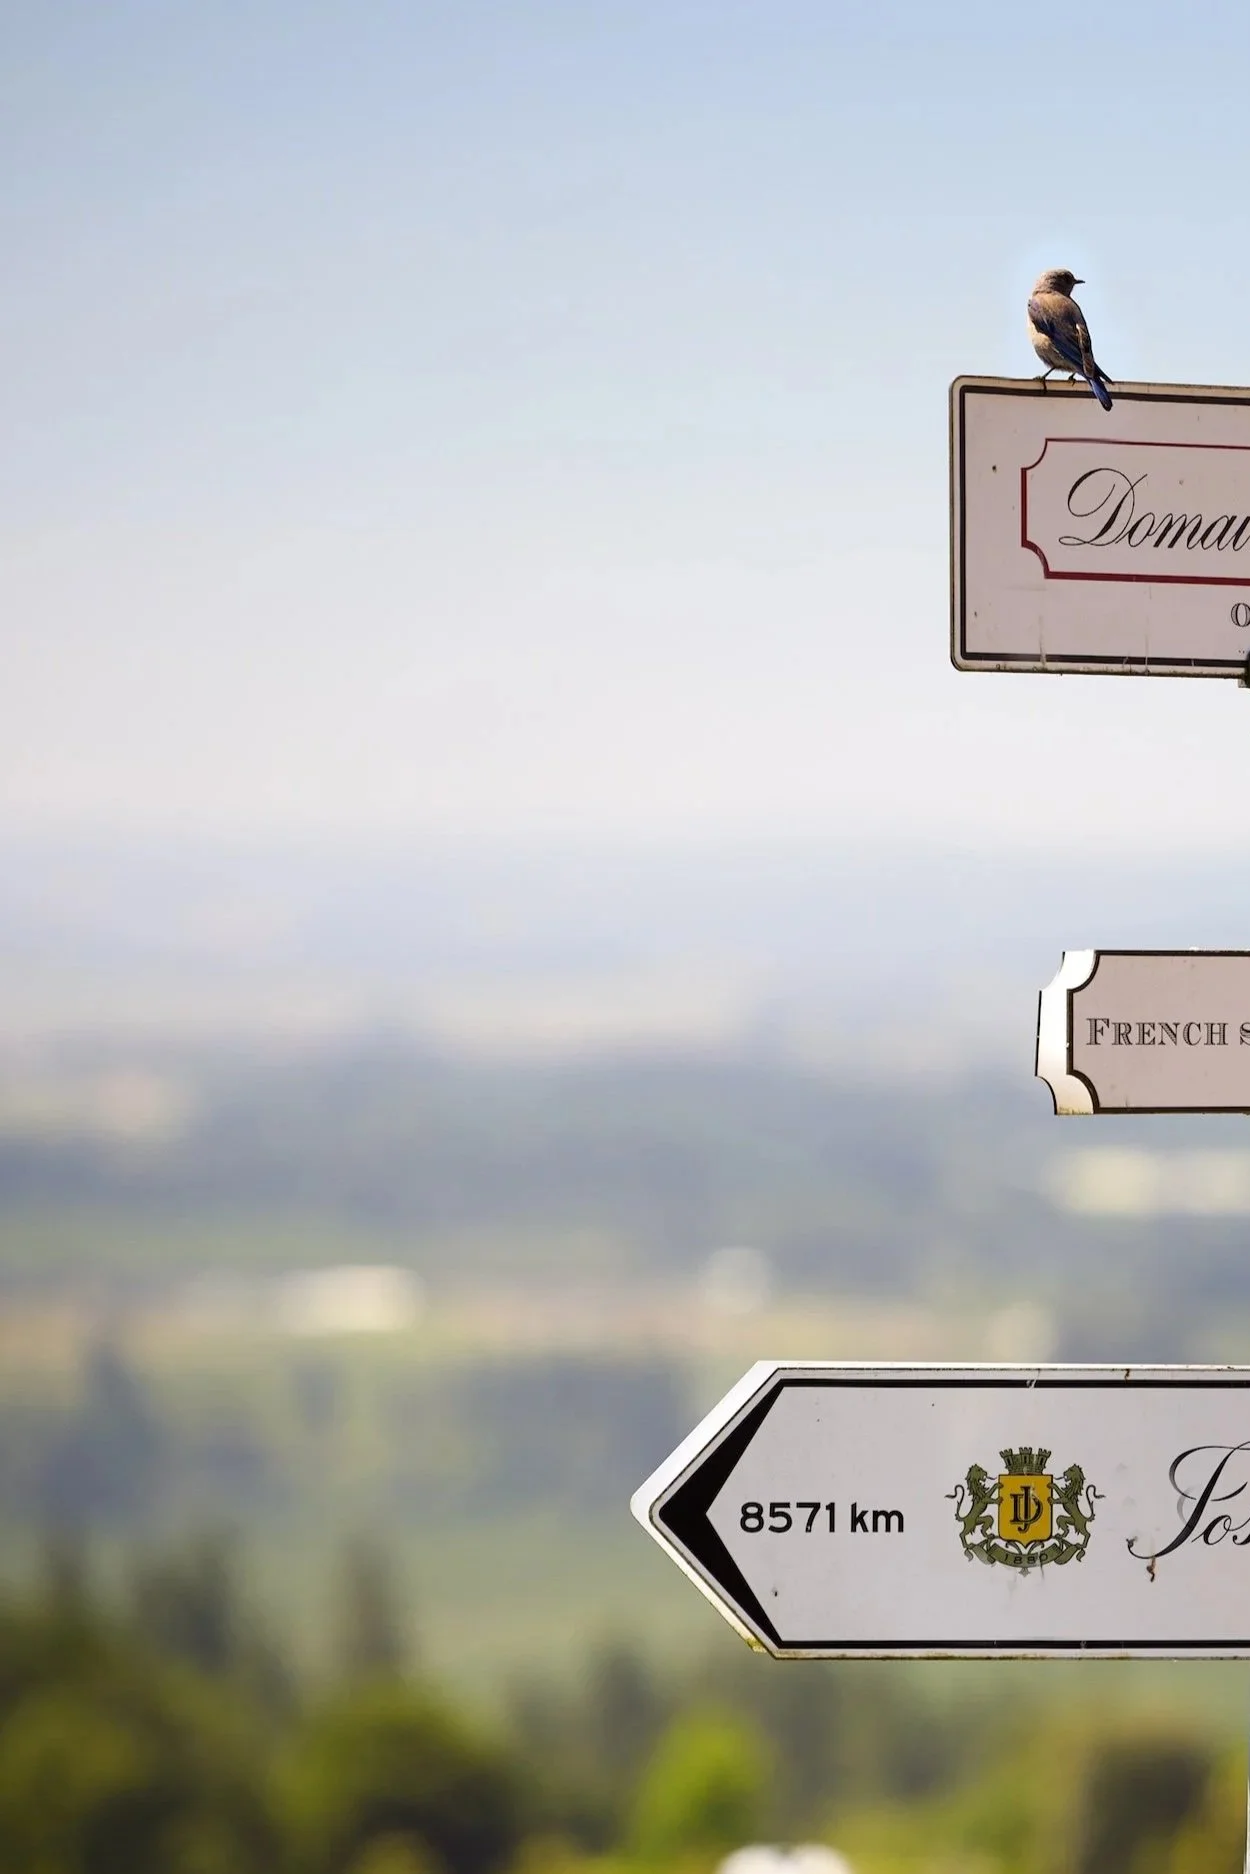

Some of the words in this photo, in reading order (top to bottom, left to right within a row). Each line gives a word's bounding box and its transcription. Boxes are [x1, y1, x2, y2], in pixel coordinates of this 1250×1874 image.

[1086, 1017, 1229, 1046] FRENCH
[739, 1502, 837, 1533] 8571
[850, 1501, 905, 1533] km
